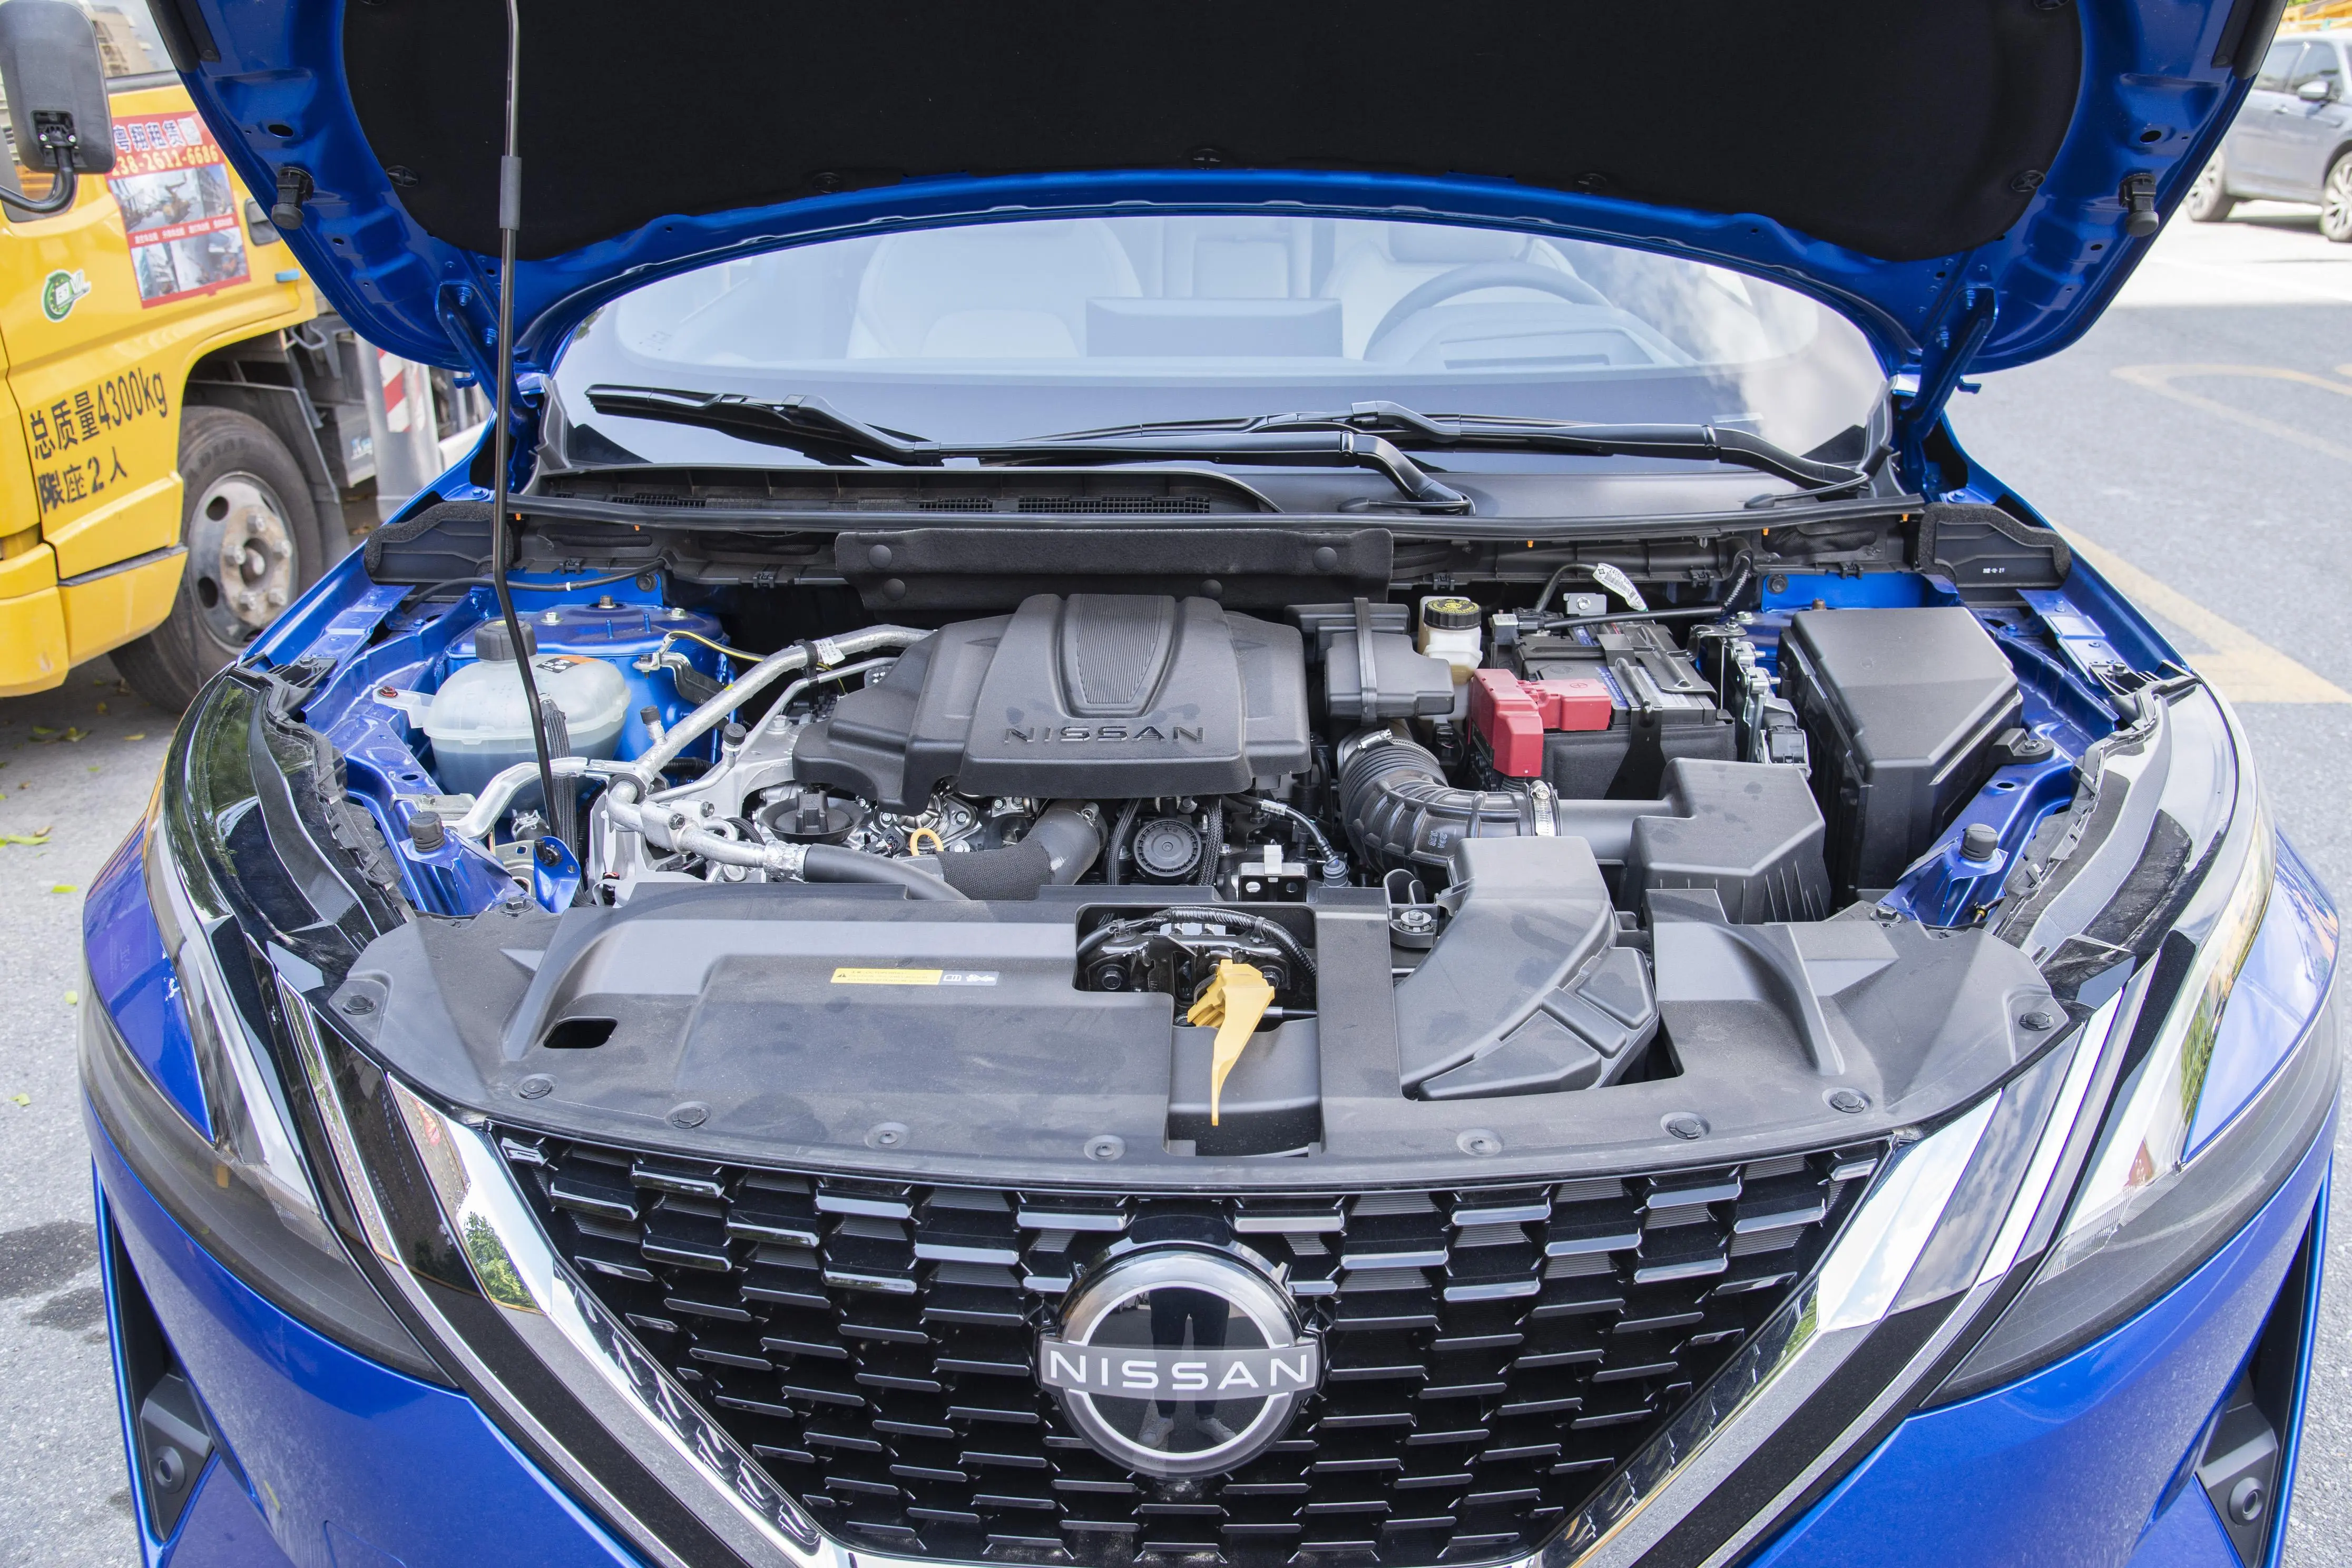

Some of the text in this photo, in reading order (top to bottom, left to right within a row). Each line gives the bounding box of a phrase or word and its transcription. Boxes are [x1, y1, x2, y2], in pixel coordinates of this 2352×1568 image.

[30, 367, 168, 460] 总质量4300kg
[37, 446, 128, 515] 限座2人
[1003, 725, 1205, 744] NISSAN
[1050, 1350, 1307, 1390] NISSAN
